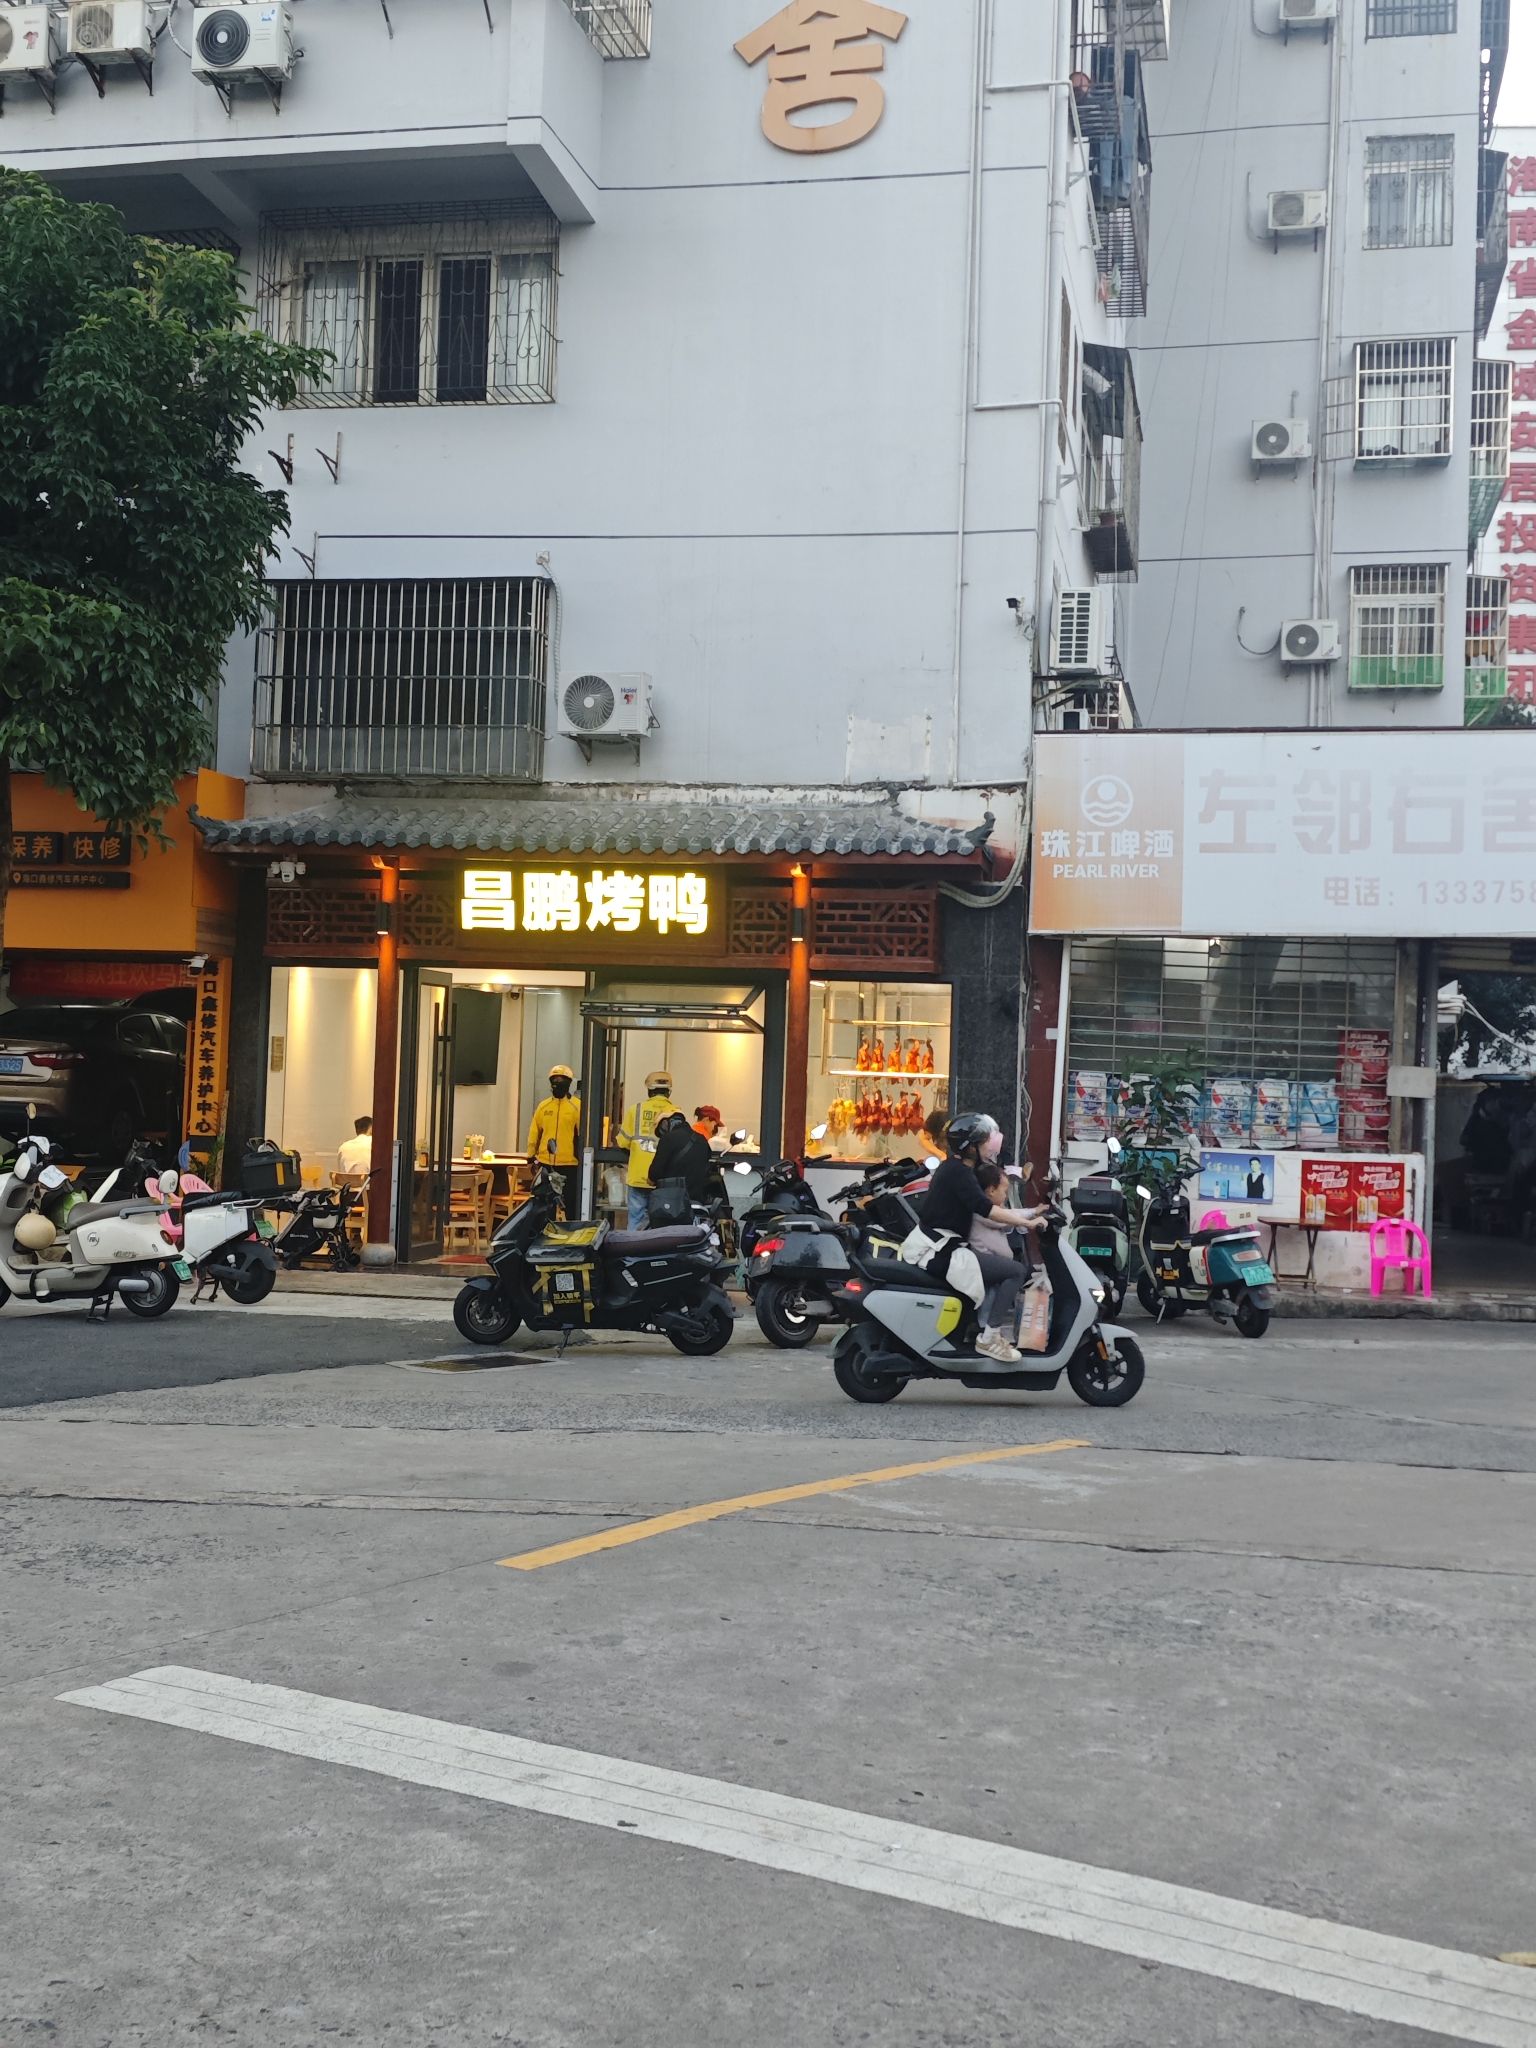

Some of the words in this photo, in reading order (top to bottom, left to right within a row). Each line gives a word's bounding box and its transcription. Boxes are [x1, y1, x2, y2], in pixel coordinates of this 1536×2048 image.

[733, 0, 908, 154] 舍
[1198, 766, 1536, 854] 左邻右舍
[73, 836, 121, 860] 快修
[1041, 829, 1174, 859] 珠江啤酒
[1053, 863, 1107, 878] PEARL
[1110, 863, 1160, 878] RIVER
[461, 870, 708, 934] 昌鹏烤鸭
[195, 960, 220, 1133] 海口鑫修汽车养护中心
